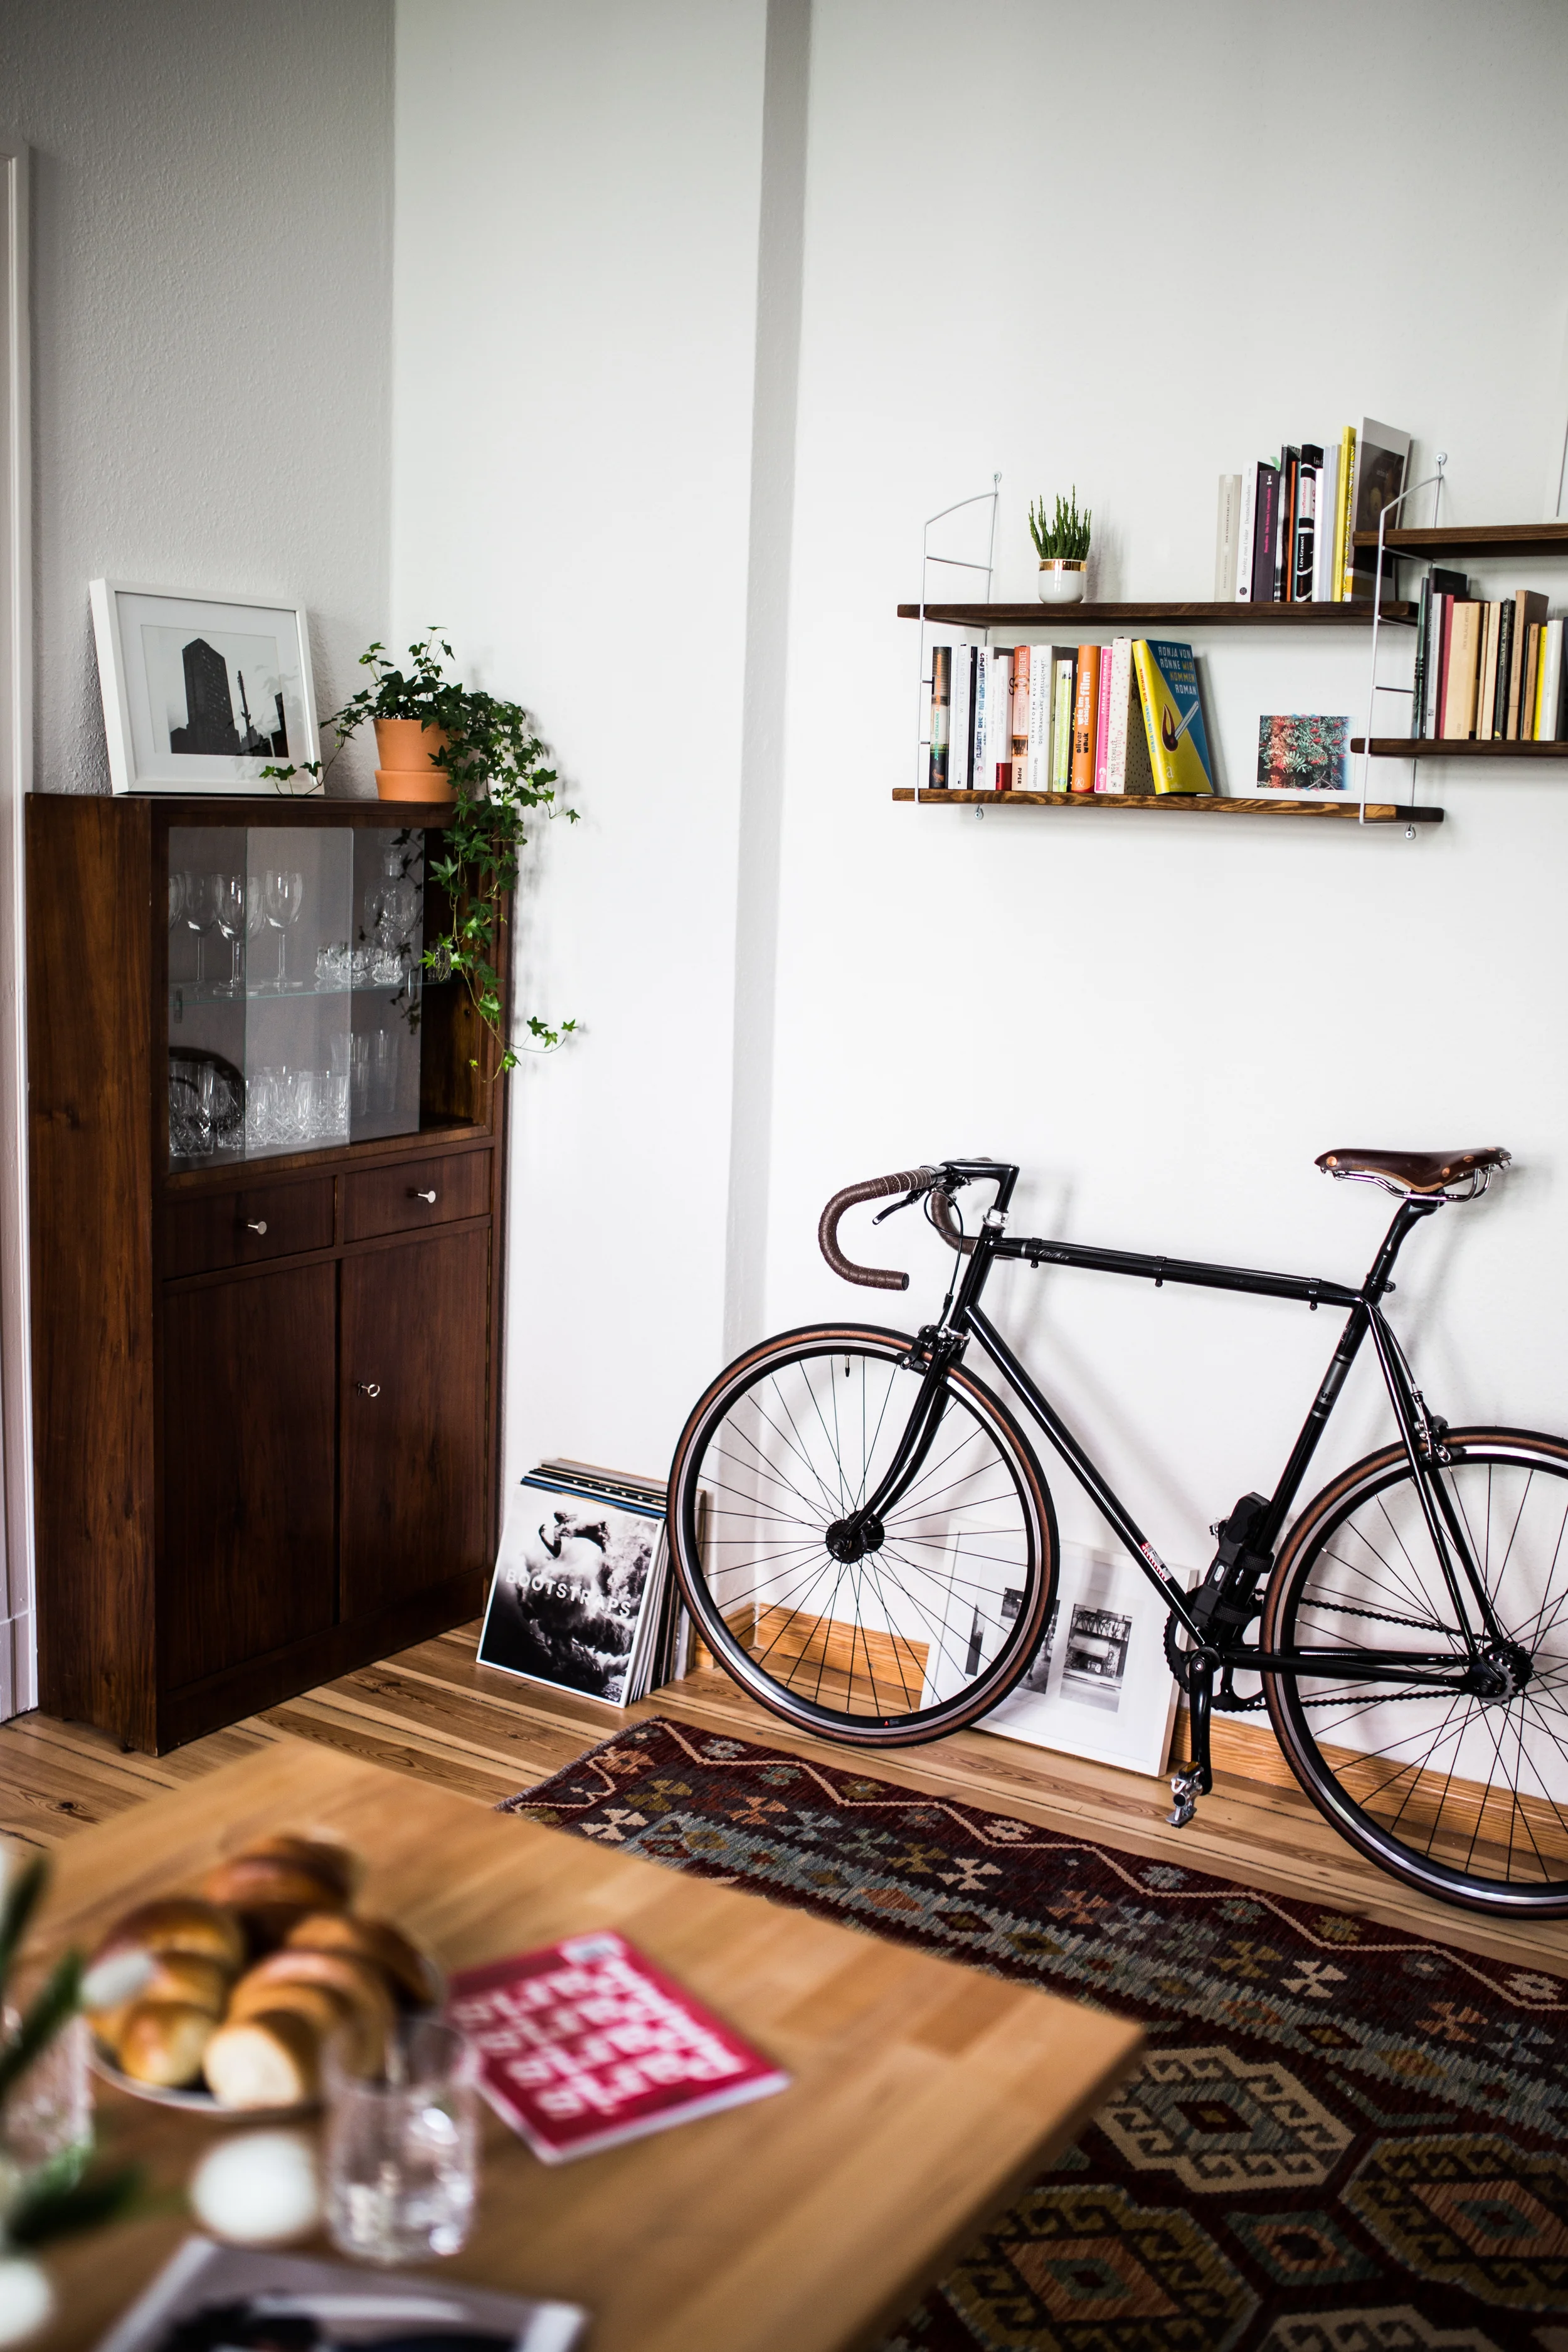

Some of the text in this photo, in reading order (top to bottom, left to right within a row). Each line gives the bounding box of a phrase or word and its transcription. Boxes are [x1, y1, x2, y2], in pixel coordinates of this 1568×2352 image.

[1158, 646, 1192, 659] RONJA VON
[1160, 657, 1194, 671] RÖNNE WIR
[1018, 650, 1027, 702] FRANKA POTENTE
[1170, 671, 1195, 683] KOMMEN
[1079, 672, 1091, 696] film
[1175, 684, 1197, 696] ROMAN
[1077, 697, 1084, 707] im
[1083, 696, 1091, 726] richtigen
[1034, 1249, 1069, 1261] Feather
[505, 1569, 631, 1618] BOOTSTRAPS
